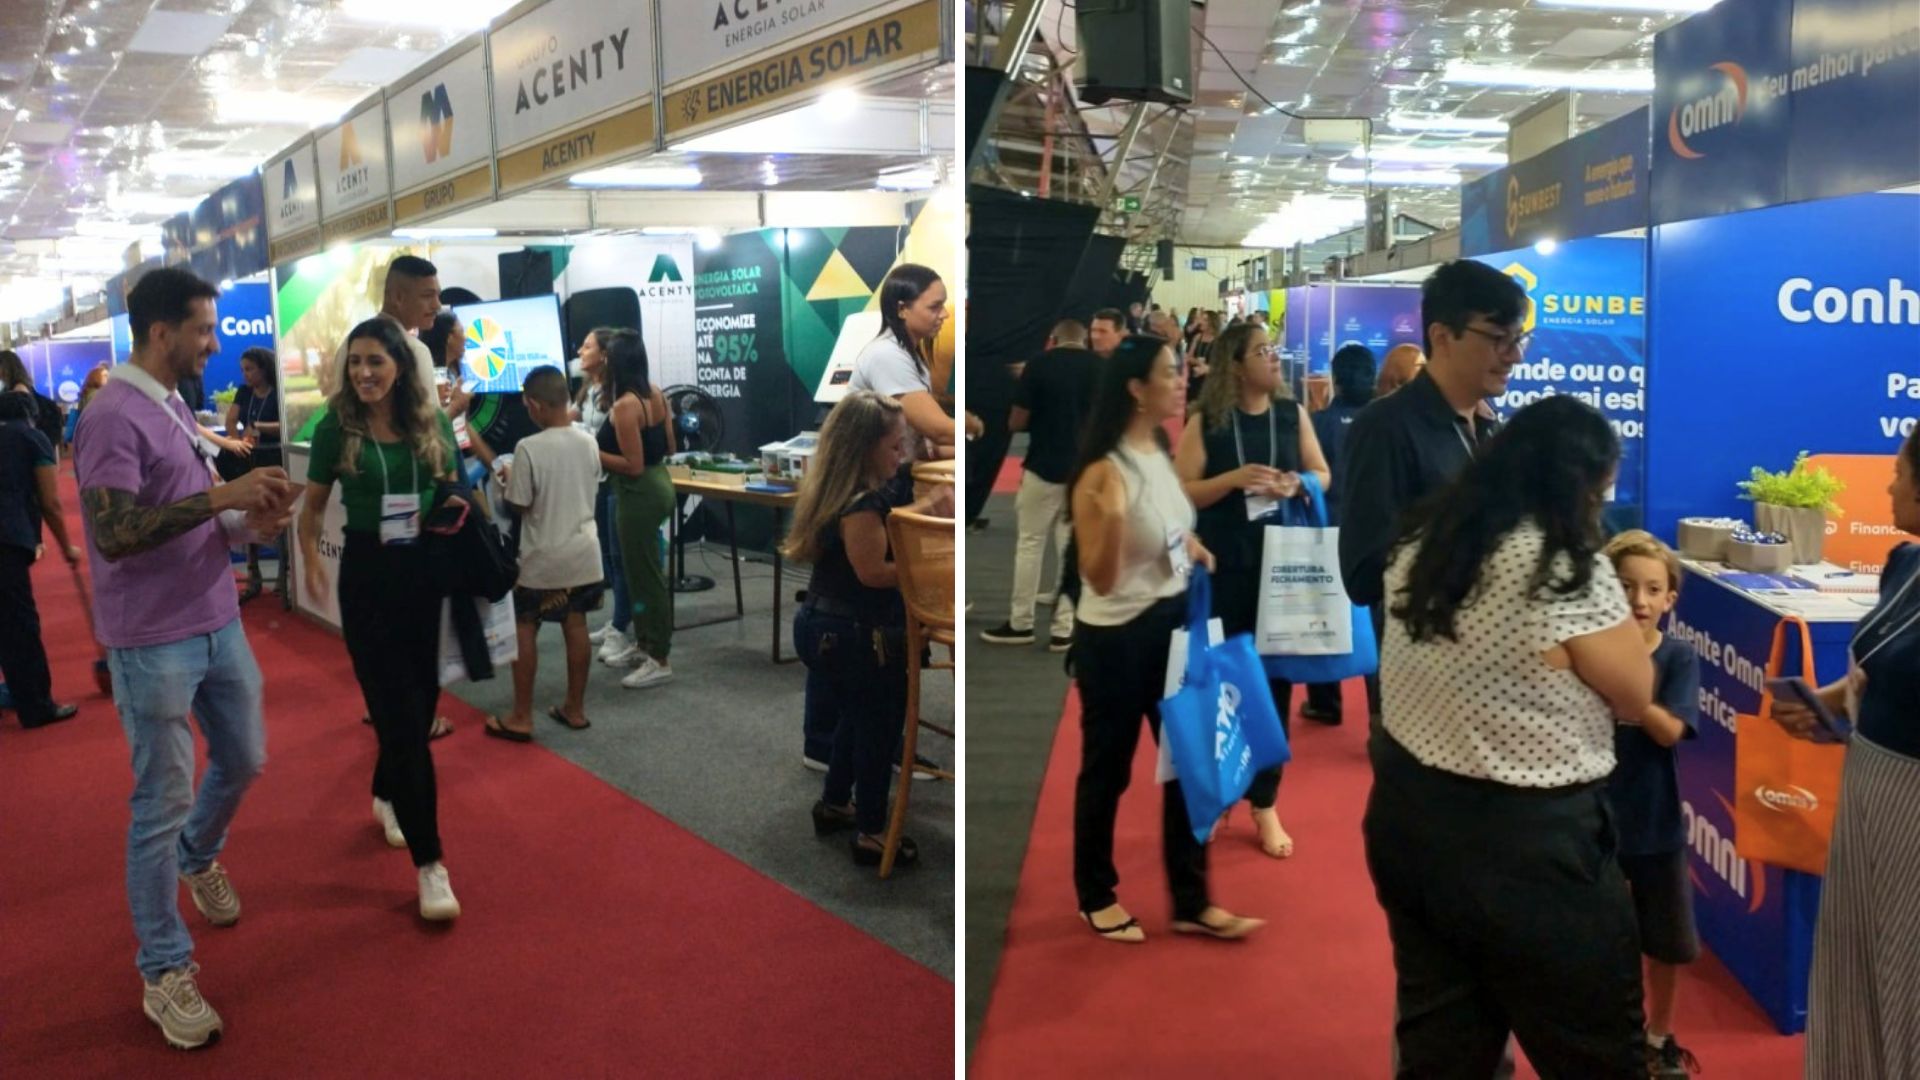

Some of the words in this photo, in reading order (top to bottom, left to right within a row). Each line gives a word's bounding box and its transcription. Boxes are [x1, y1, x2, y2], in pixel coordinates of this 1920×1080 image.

[725, 17, 777, 48] ENERGIA
[781, 0, 825, 25] SOLAR
[514, 27, 630, 115] ACENTY
[706, 55, 804, 113] ENERGIA
[808, 19, 902, 79] SOLAR
[1791, 51, 1856, 91] melhor
[1681, 90, 1734, 138] omni
[541, 130, 597, 171] ACENTY
[336, 166, 369, 194] ACENTY
[423, 182, 455, 210] GRUPO
[1518, 181, 1562, 217] SUNBEST
[731, 265, 762, 281] SOLAR
[639, 286, 692, 297] ACENTY
[1543, 294, 1645, 315] SUNBE
[1777, 277, 1920, 325] Conh
[696, 313, 756, 332] ECONOMIZE
[1543, 317, 1582, 325] ENERGIA
[1585, 318, 1615, 326] SOLAR
[697, 330, 714, 348] ATÉ
[715, 333, 759, 363] 95%
[697, 351, 713, 364] NA
[698, 367, 732, 381] CONTA
[733, 366, 747, 381] DE
[1507, 357, 1567, 381] nde
[1569, 363, 1605, 382] ou
[1608, 364, 1626, 382] o
[1887, 372, 1920, 400] Pa
